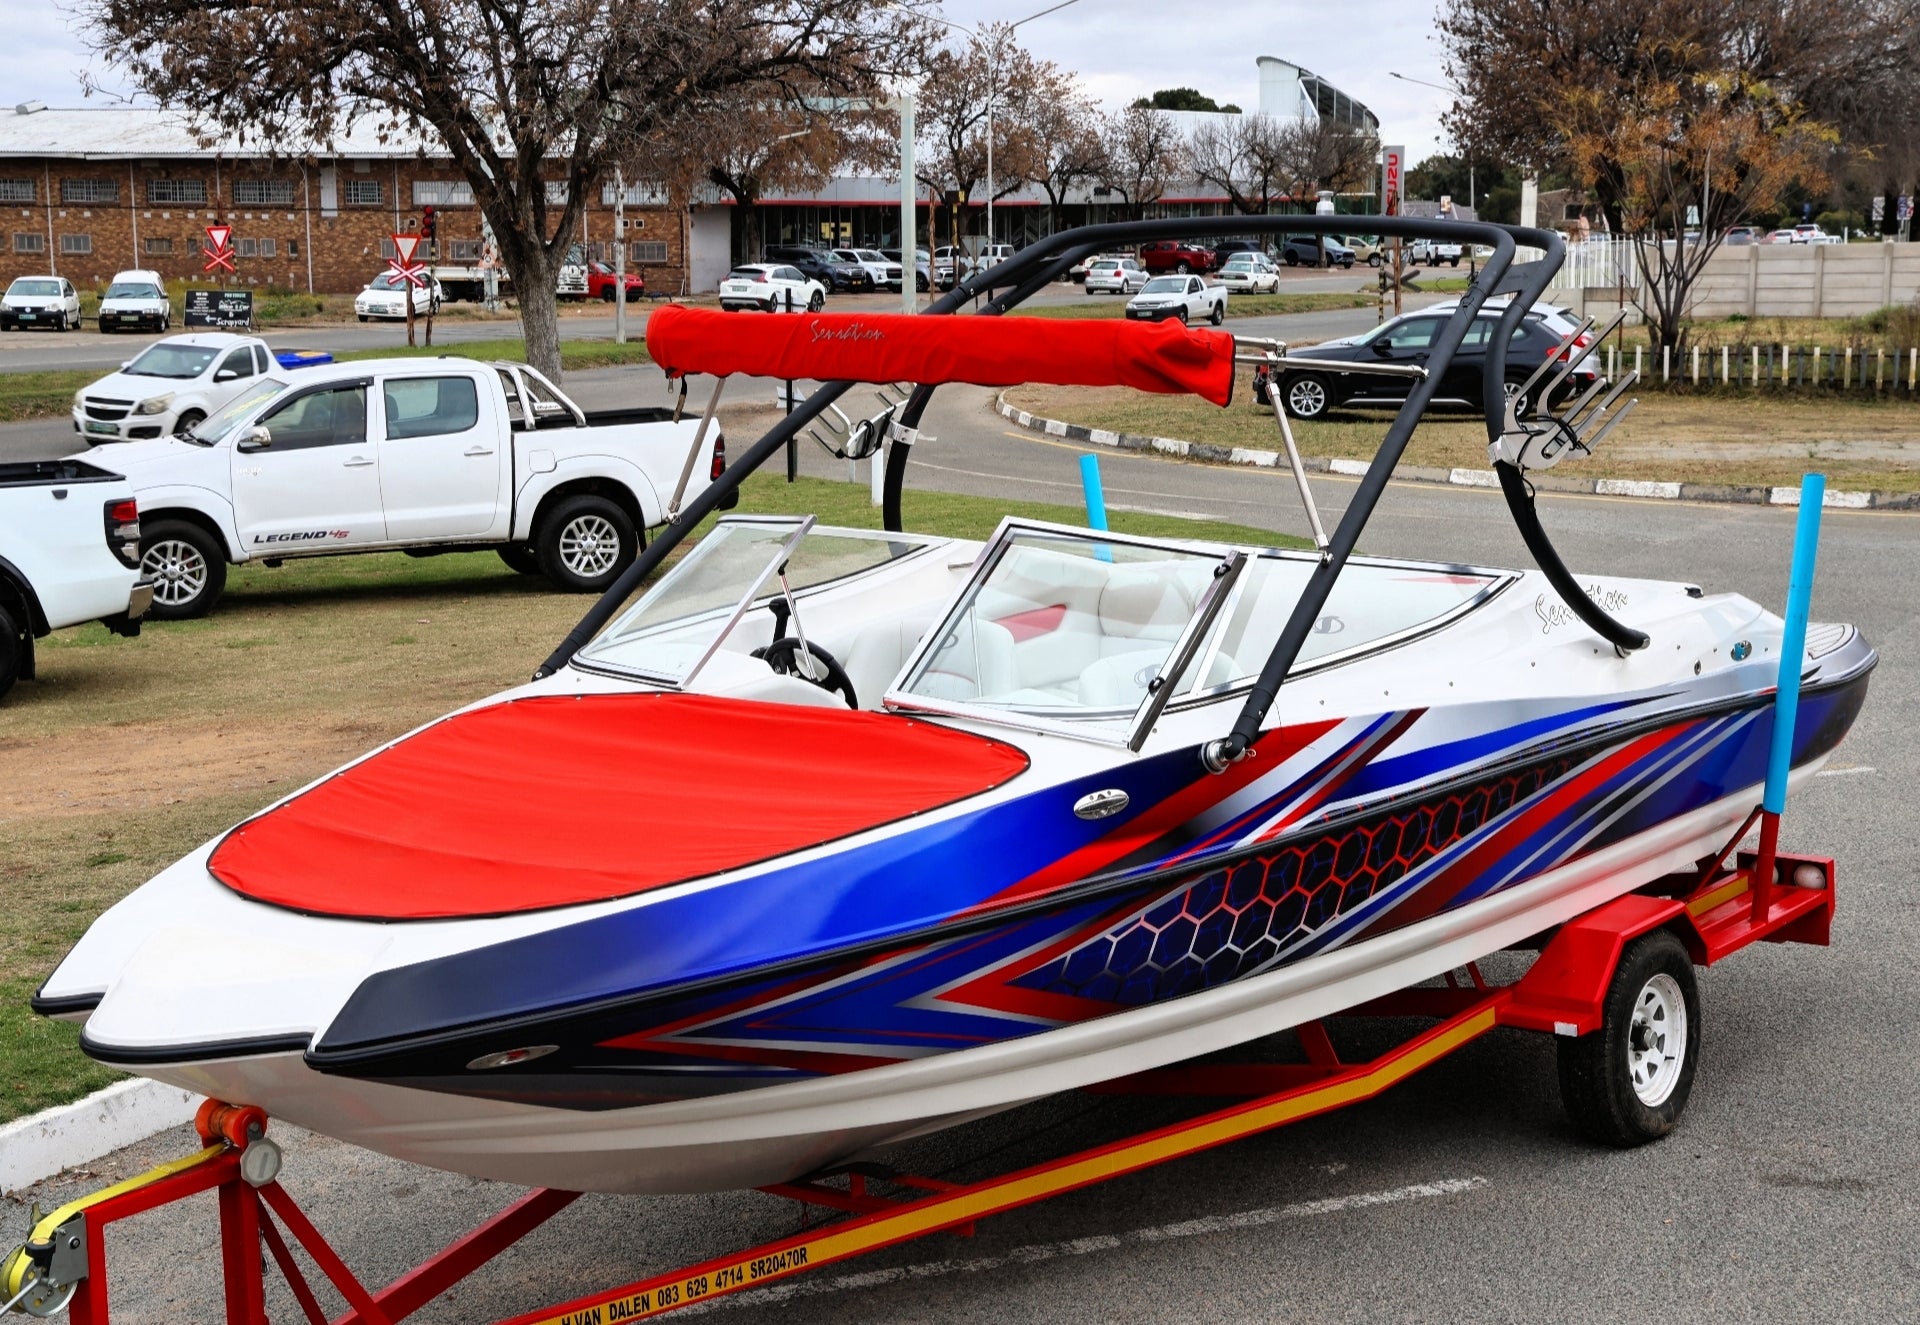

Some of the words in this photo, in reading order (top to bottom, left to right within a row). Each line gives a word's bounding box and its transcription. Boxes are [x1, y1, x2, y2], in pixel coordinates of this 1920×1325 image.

[216, 317, 250, 328] Scrapyard
[811, 319, 885, 342] Sensation
[253, 531, 327, 544] LEGEND
[1535, 585, 1628, 635] Sention
[574, 1307, 601, 1325] VAN
[608, 1293, 650, 1321] DALEN
[657, 1285, 680, 1307] 083
[686, 1276, 708, 1298] 629
[715, 1265, 743, 1289] 4714
[750, 1246, 808, 1279] SR20470R
